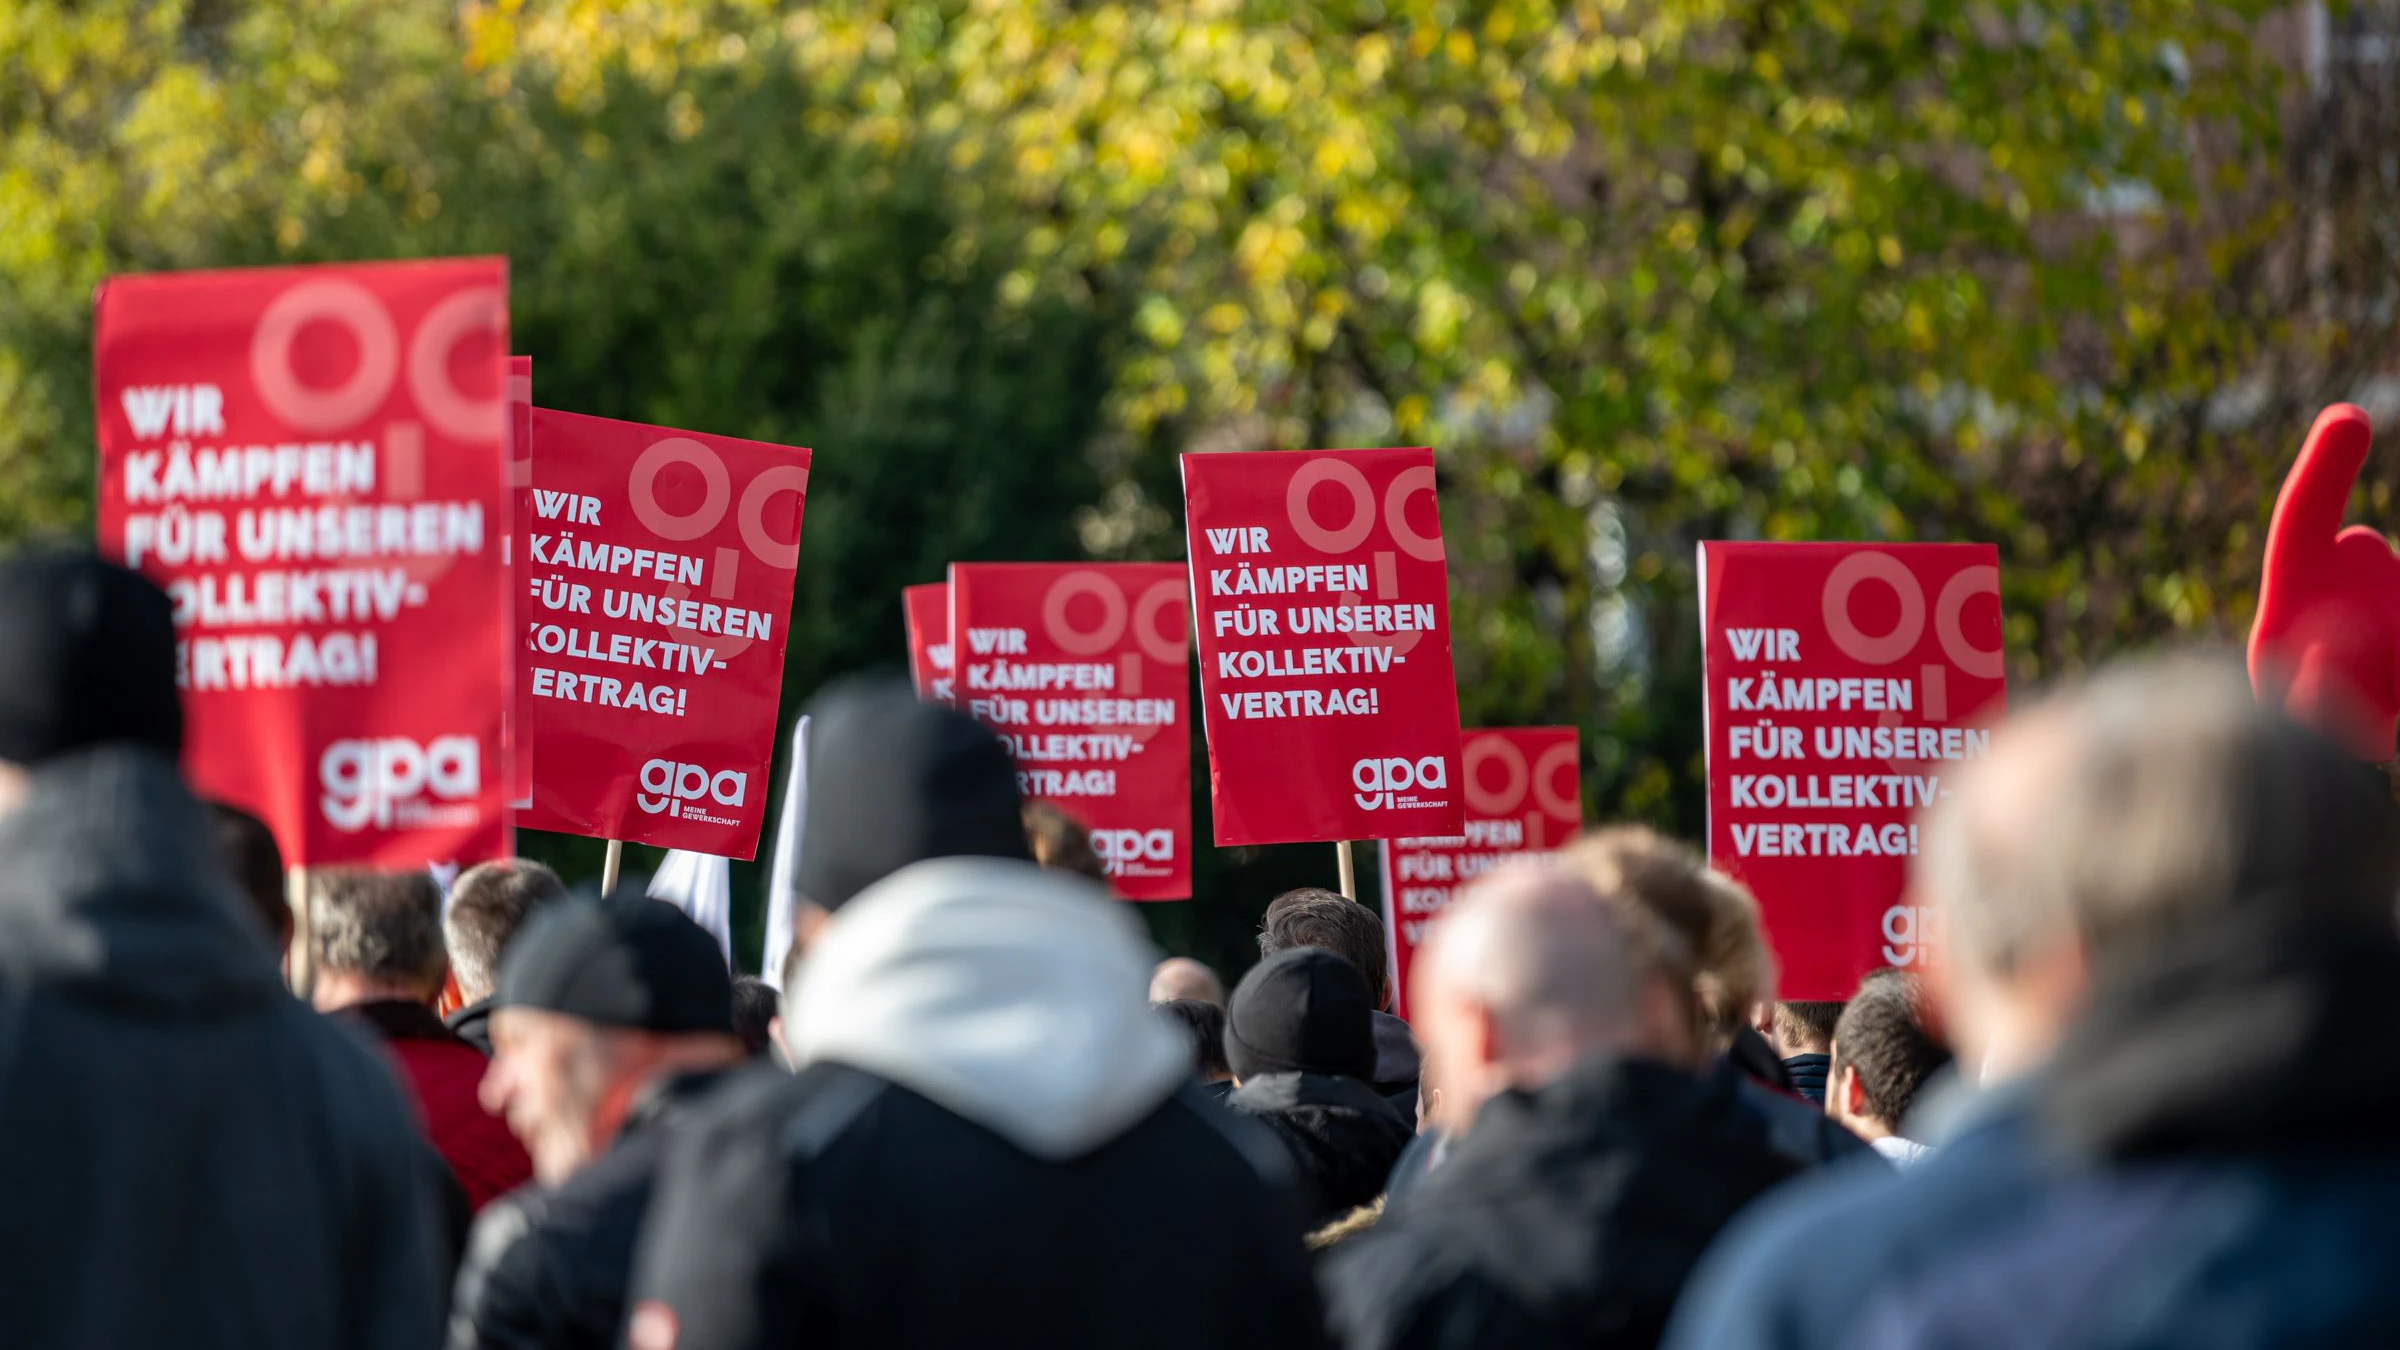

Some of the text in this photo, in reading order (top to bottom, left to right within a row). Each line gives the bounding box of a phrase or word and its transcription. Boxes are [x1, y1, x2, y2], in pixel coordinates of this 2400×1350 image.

[122, 384, 224, 438] WIR
[123, 441, 376, 503] KÄMPFEN
[532, 488, 602, 526] WIR
[124, 501, 483, 570] FÜR UNSEREN
[1205, 527, 1272, 555] WIR
[530, 530, 704, 586] KÄMPFEN
[1210, 562, 1369, 596] KÄMPFEN
[167, 569, 428, 627] OLLEKTIV-
[602, 588, 772, 641] UNSEREN
[1214, 603, 1436, 637] FÜR UNSEREN
[967, 628, 1027, 655] WIR
[1725, 628, 1801, 661] WIR
[175, 630, 378, 691] RTRAG!
[967, 659, 1115, 690] KÄMPFEN
[1218, 646, 1406, 679] KOLLEKTIV-
[530, 667, 687, 717] ERTRAG!
[1220, 688, 1379, 720] VERTRAG!
[1728, 671, 1913, 711] KÄMPFEN
[970, 694, 1175, 726] FÜR UNSEREN
[996, 734, 1144, 761] LLEKTIV-
[1729, 719, 1990, 760] FÜR UNSEREN
[320, 735, 480, 831] gpa
[637, 758, 748, 817] gpa
[1015, 769, 1116, 797] RTRAG!
[1352, 756, 1448, 811] gpa
[1730, 775, 1952, 808] KOLLEKTIV-
[682, 812, 741, 827] GEWERKSCHAFT
[683, 805, 707, 815] MEINE
[1397, 801, 1448, 809] GEWERKSCHAFT
[1731, 823, 1919, 857] VERTRAG!
